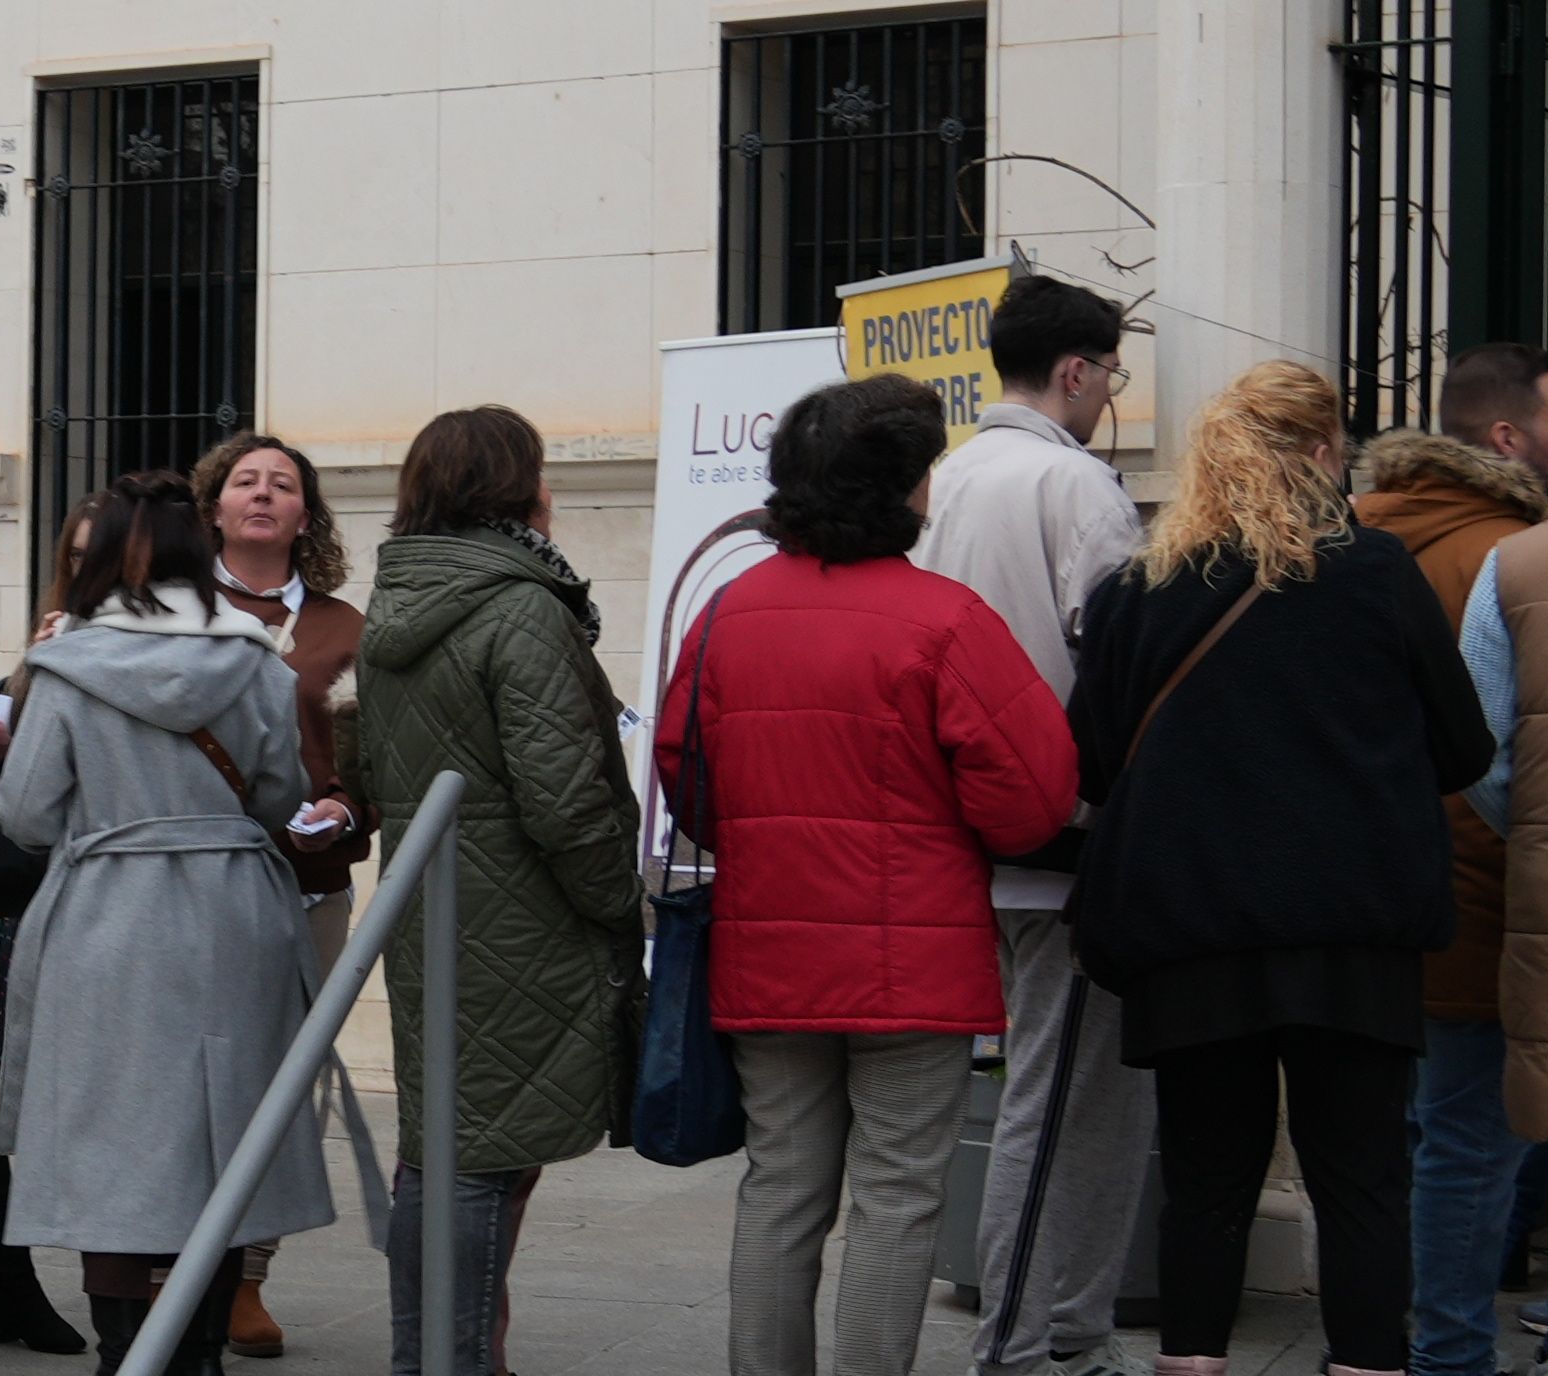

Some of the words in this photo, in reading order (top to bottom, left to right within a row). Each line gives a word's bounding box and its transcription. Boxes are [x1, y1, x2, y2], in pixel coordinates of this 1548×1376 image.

[862, 296, 993, 368] PROYECTO
[689, 465, 706, 484] te
[711, 464, 748, 483] abre
